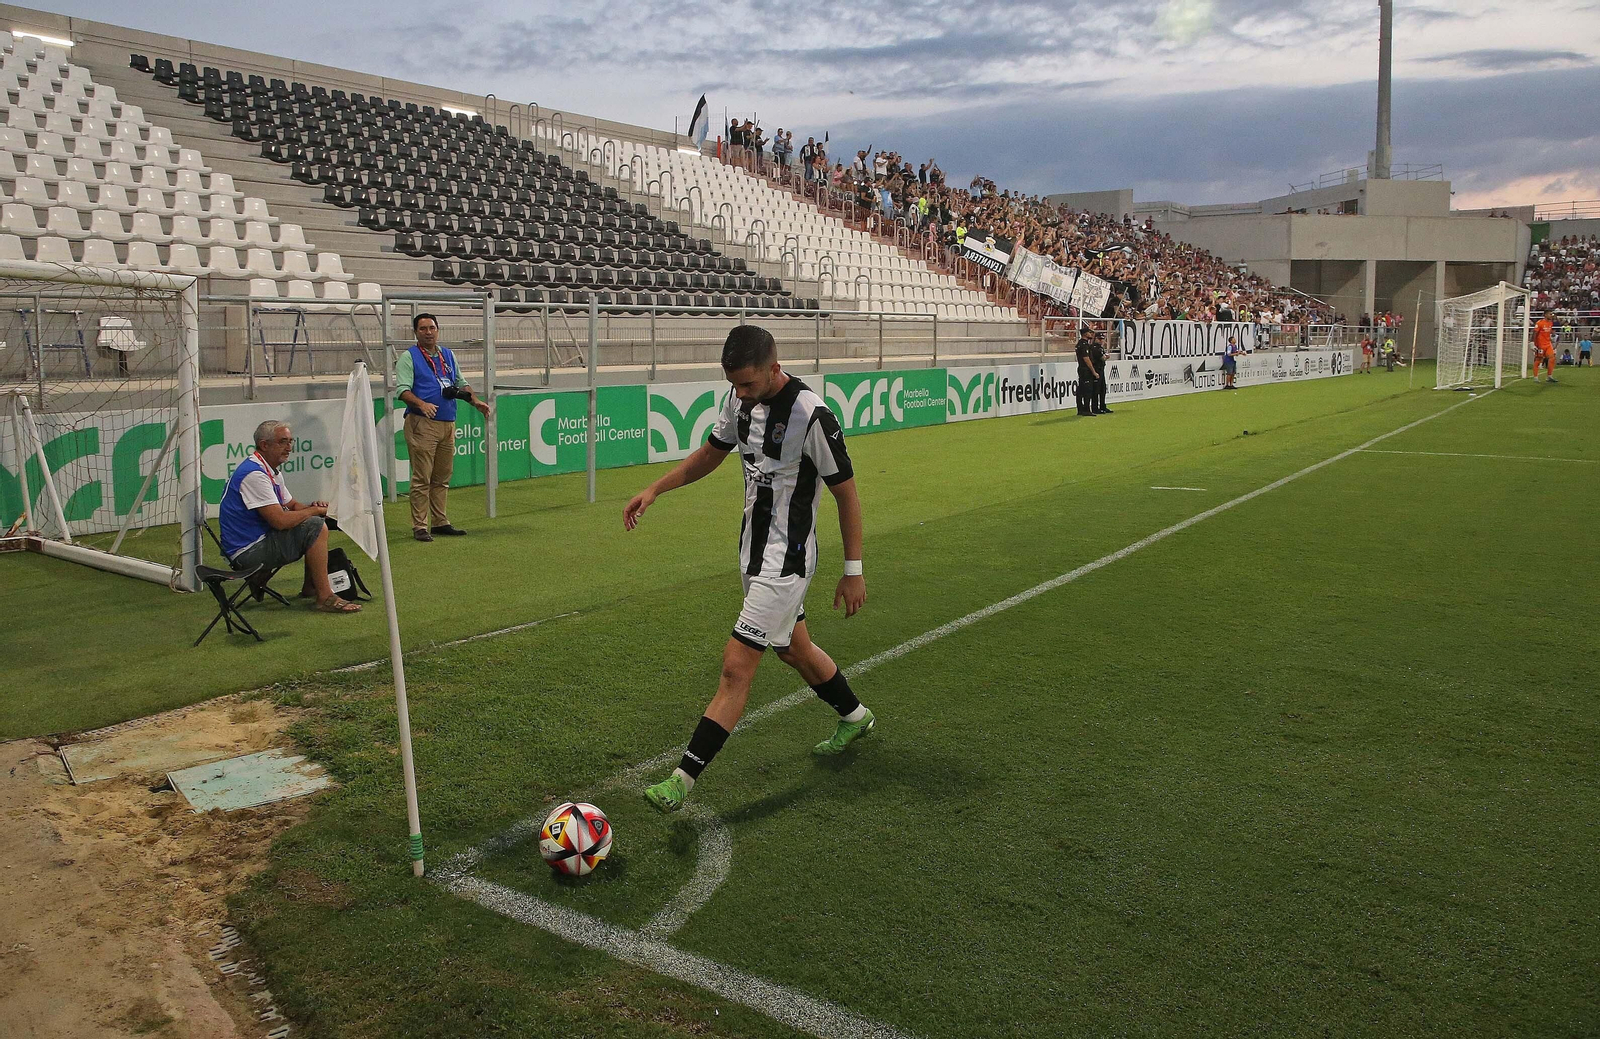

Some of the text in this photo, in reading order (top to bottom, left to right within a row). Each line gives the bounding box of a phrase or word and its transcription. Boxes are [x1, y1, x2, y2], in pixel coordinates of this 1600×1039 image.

[1194, 373, 1216, 389] LOTUS
[904, 388, 929, 398] Marbella
[903, 398, 946, 409] Football Center
[557, 414, 611, 430] Marblla
[608, 428, 645, 441] Center
[479, 438, 527, 454] Cnter
[740, 621, 767, 639] LEGEA
